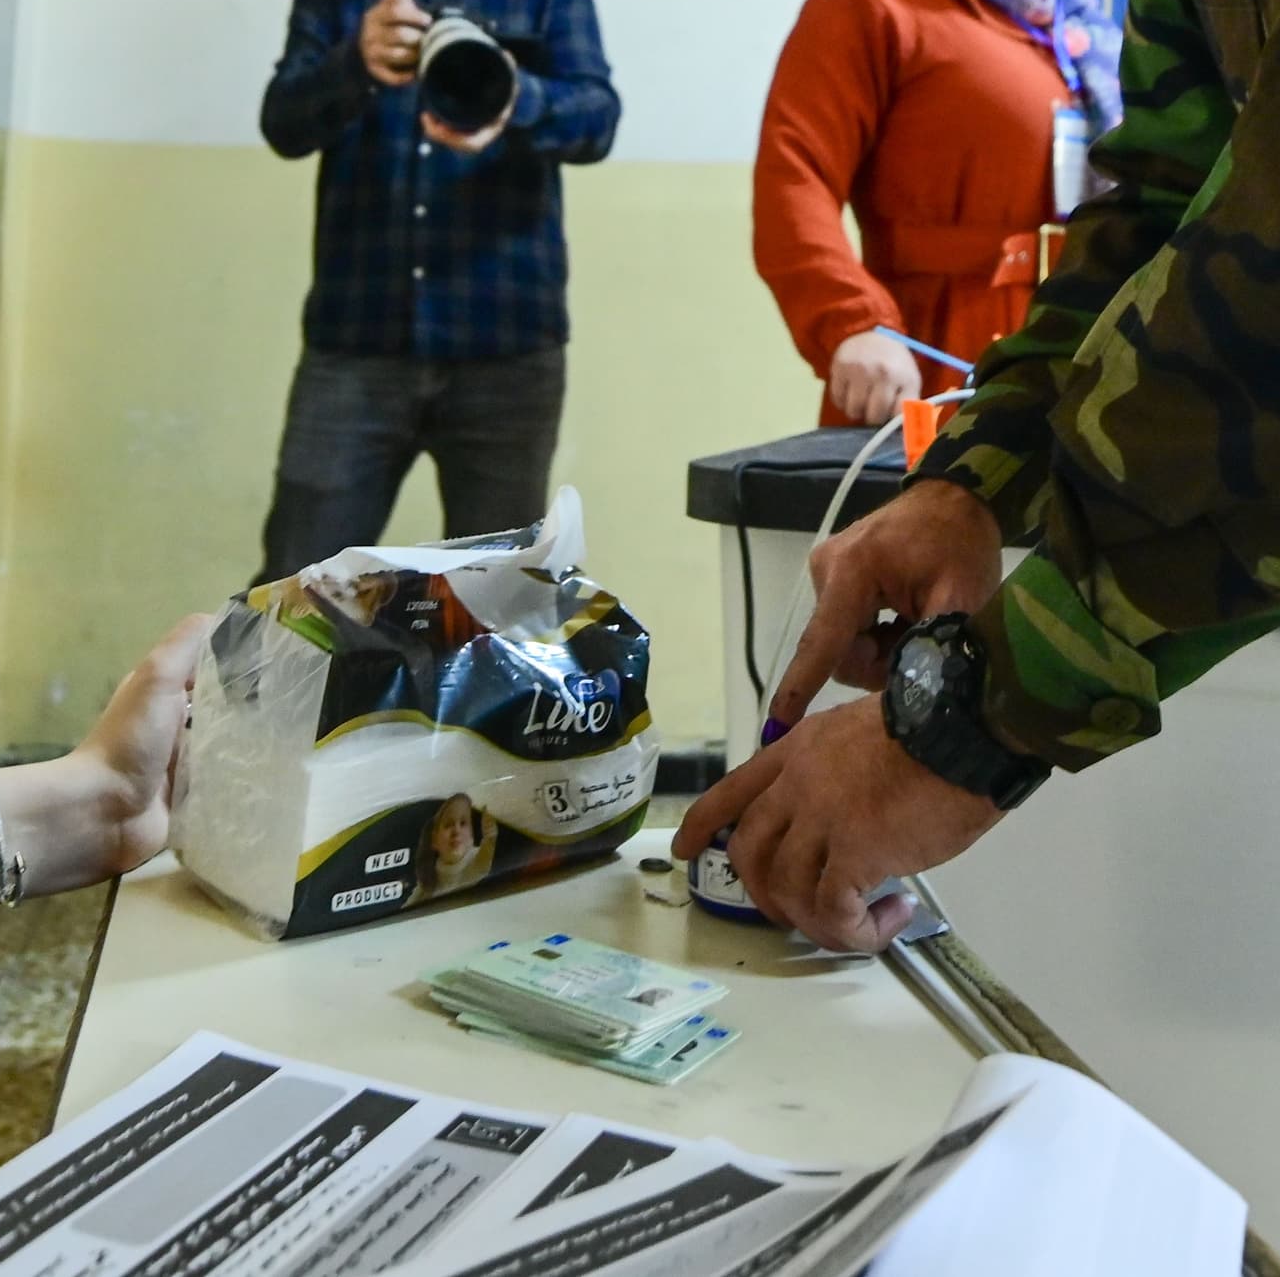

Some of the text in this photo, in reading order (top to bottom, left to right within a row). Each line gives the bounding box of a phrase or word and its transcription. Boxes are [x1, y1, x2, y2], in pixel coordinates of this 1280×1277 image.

[548, 784, 568, 814] 3
[372, 850, 405, 869] NEW
[335, 883, 398, 908] PRODUCT
